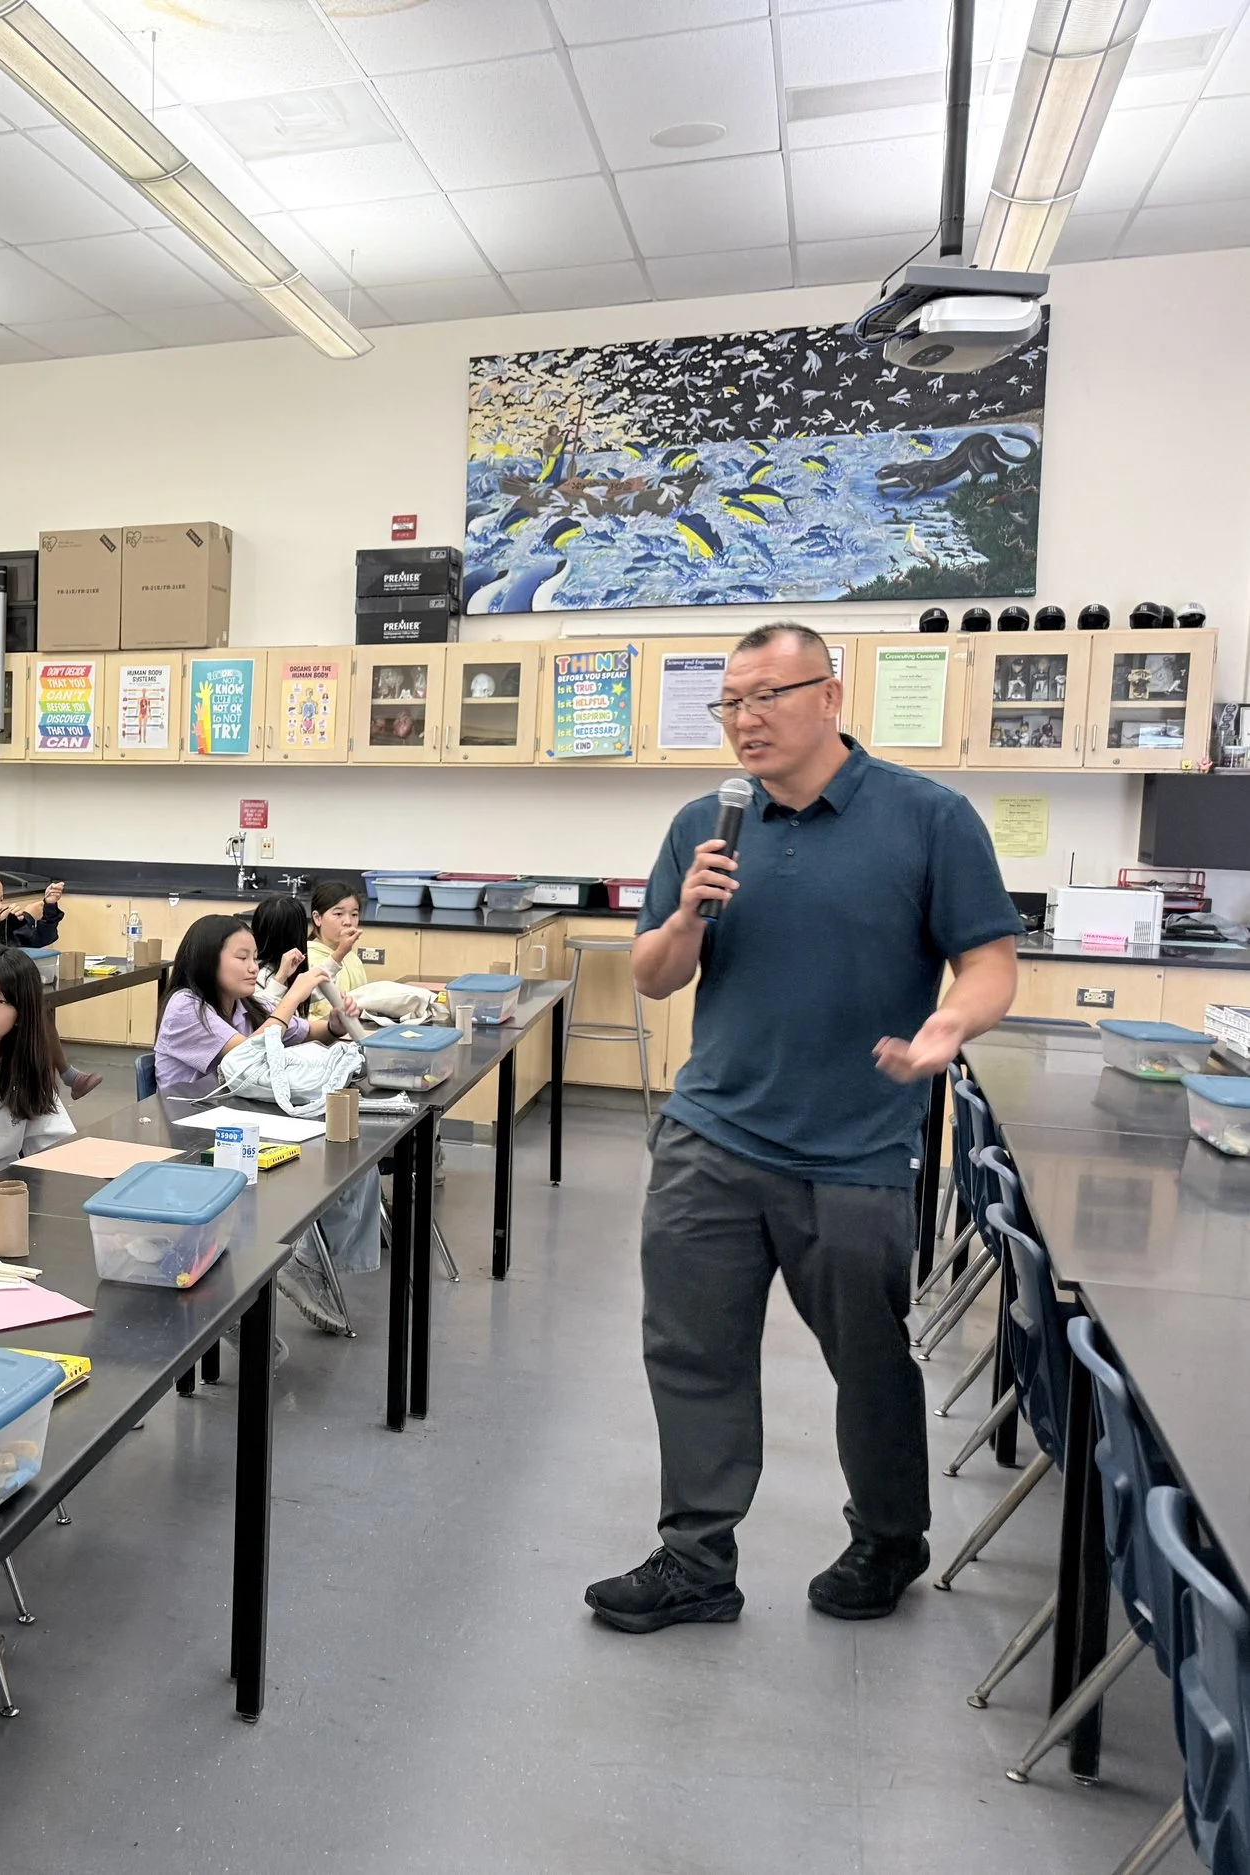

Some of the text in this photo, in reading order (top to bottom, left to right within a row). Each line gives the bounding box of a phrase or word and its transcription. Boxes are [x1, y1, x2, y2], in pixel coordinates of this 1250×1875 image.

[384, 572, 421, 582] PREMIER
[384, 620, 421, 630] PREMIER
[556, 652, 629, 675] THINK
[46, 667, 86, 676] DON'T DECIDE
[558, 674, 584, 682] BEFORE
[47, 679, 86, 688] THAT YOU
[558, 686, 565, 694] Is
[566, 685, 572, 693] it
[576, 684, 594, 692] TRUE
[46, 690, 86, 700] CAN'T
[46, 702, 86, 712] BEFORE YOU
[558, 700, 565, 708] Is
[566, 700, 572, 708] it
[576, 698, 608, 706] HELPFUL
[213, 704, 242, 713] NOT OK
[46, 714, 86, 724] DISCOVER
[213, 714, 242, 723] to NOT
[558, 714, 565, 723] Is
[566, 714, 572, 722] it
[576, 712, 610, 720] INSPIRING
[46, 726, 84, 736] THAT YOU
[212, 724, 242, 740] TRY.
[558, 729, 565, 738] Is
[566, 728, 572, 736] it
[576, 726, 618, 735] NECESSARY
[46, 736, 83, 748] CAN
[558, 744, 565, 752] Is
[566, 743, 572, 751] it
[576, 742, 591, 750] KIND
